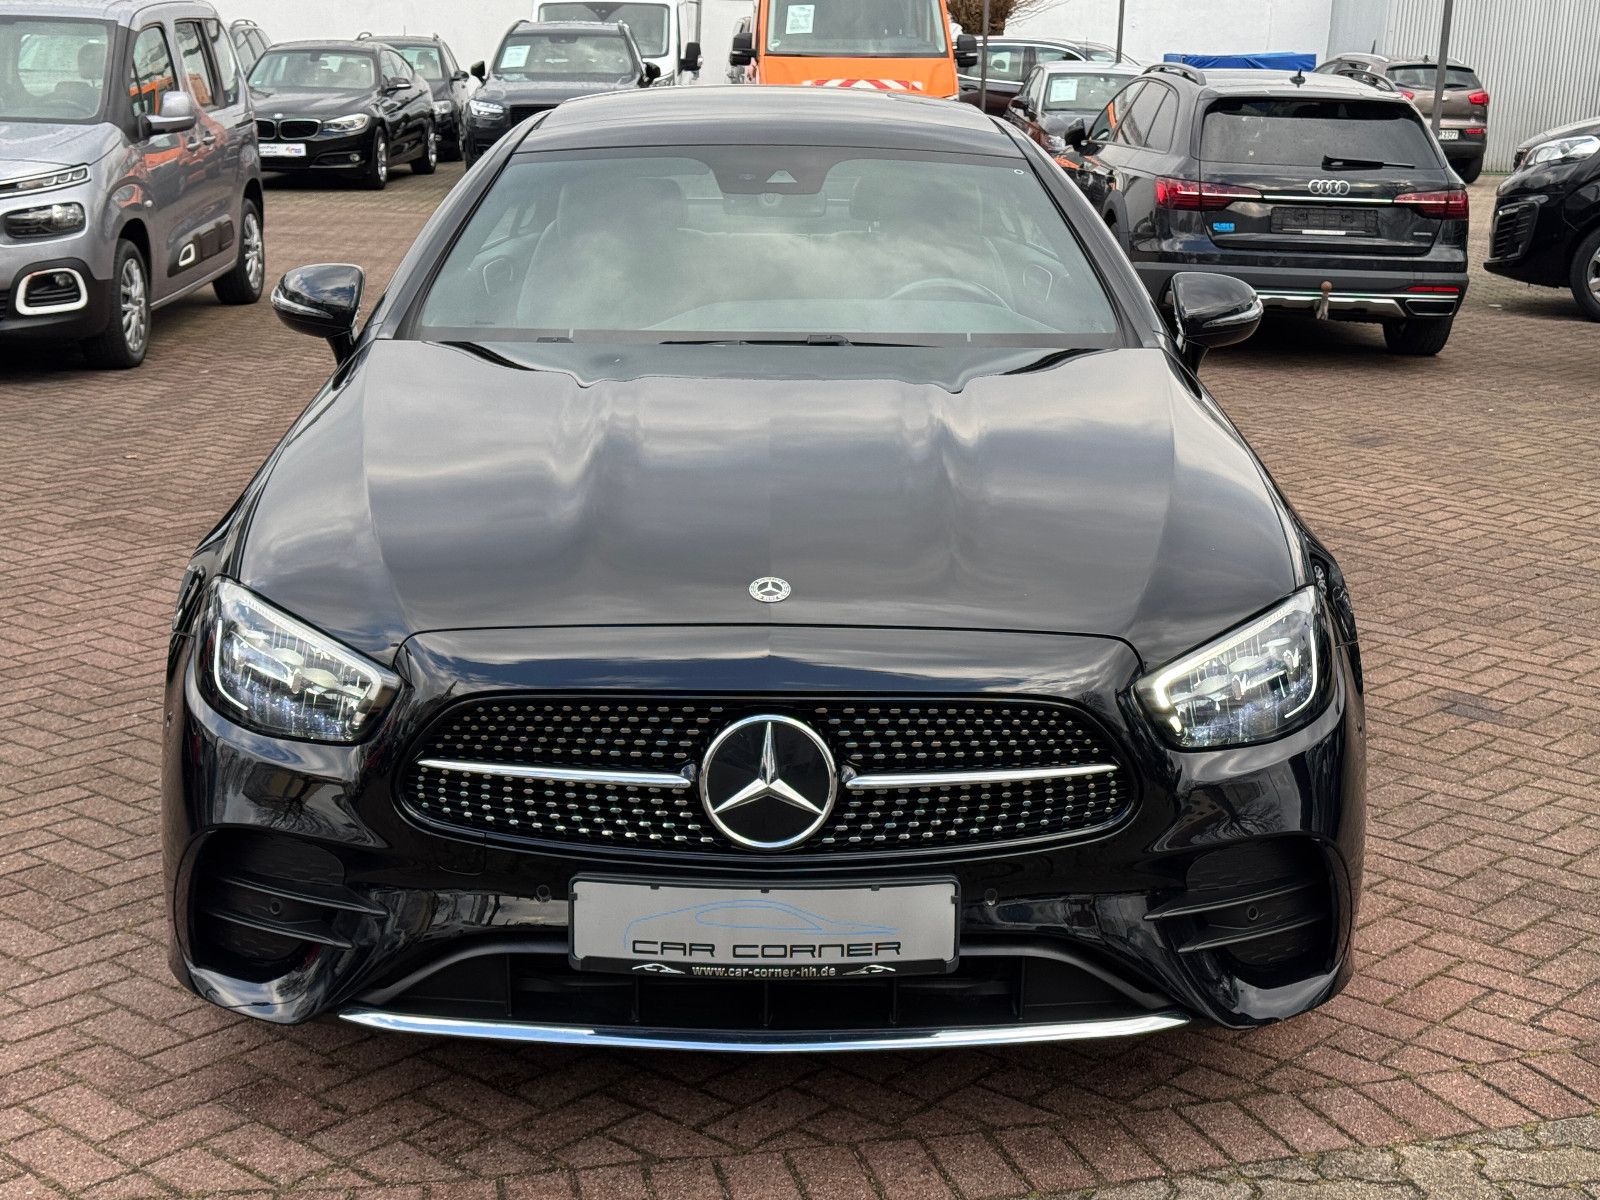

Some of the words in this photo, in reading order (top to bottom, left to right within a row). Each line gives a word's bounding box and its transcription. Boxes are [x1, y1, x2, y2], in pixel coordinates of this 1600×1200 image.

[632, 940, 716, 959] CAR
[732, 942, 901, 960] CORNER
[692, 966, 836, 979] www.car-corner-hh.de
